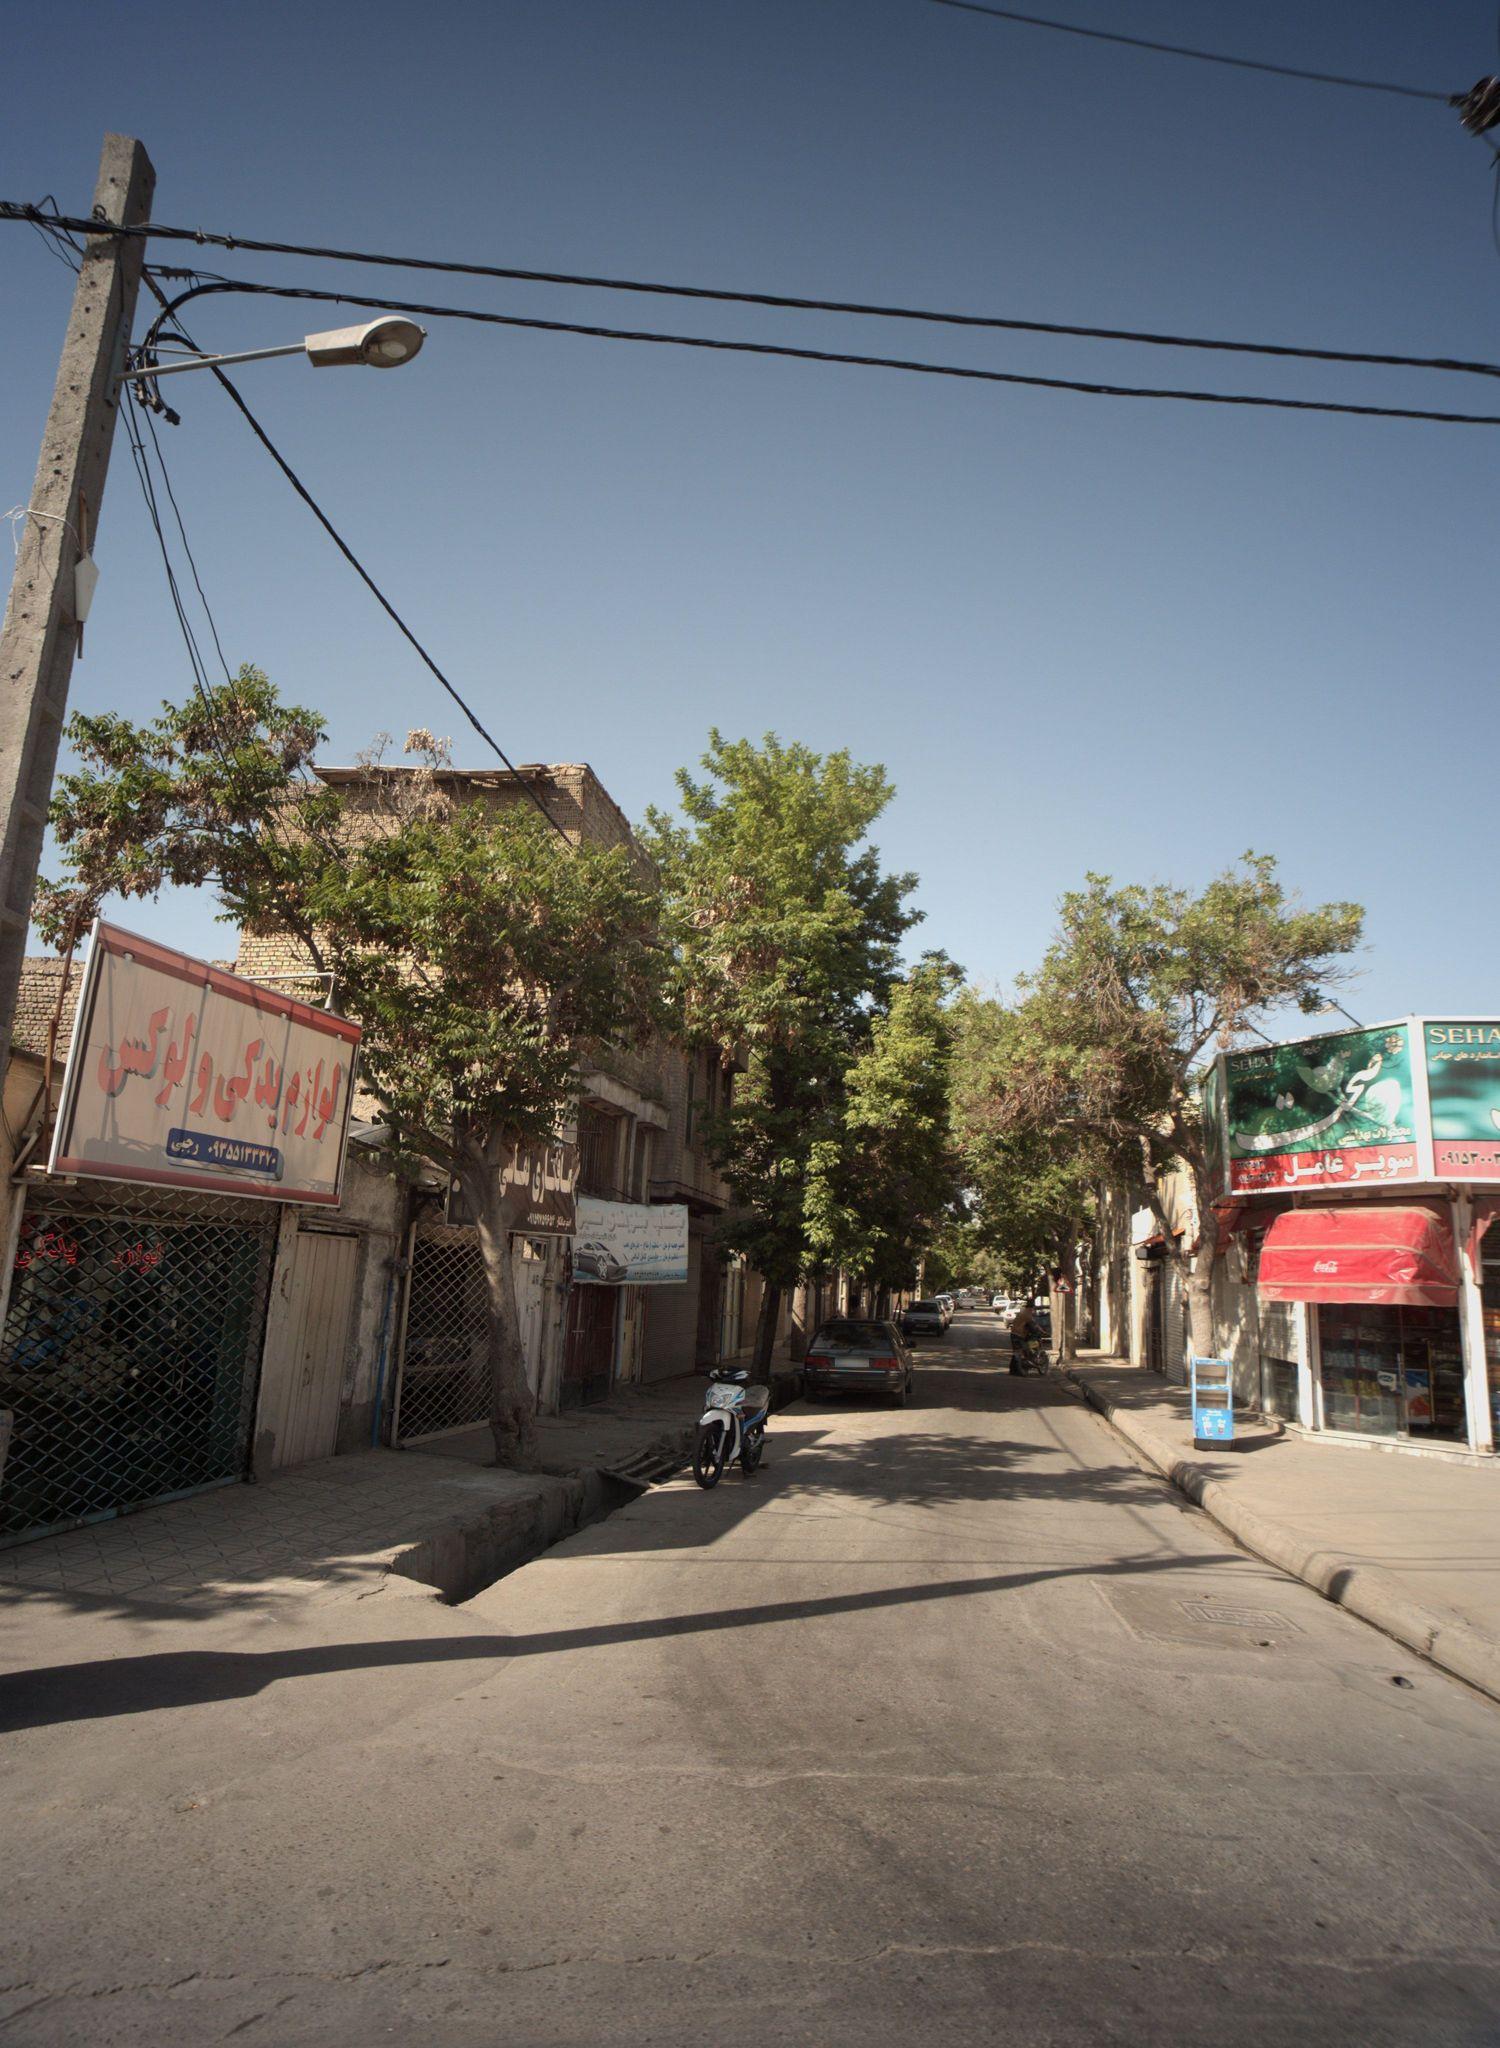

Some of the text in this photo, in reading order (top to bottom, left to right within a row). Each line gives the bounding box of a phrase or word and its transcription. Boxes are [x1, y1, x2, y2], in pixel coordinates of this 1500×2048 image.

[97, 1006, 342, 1141] لوازم یدکی و لوکس
[1231, 1054, 1276, 1072] SEHAT
[1283, 1152, 1344, 1184] عامل
[1350, 1154, 1414, 1180] سوپر
